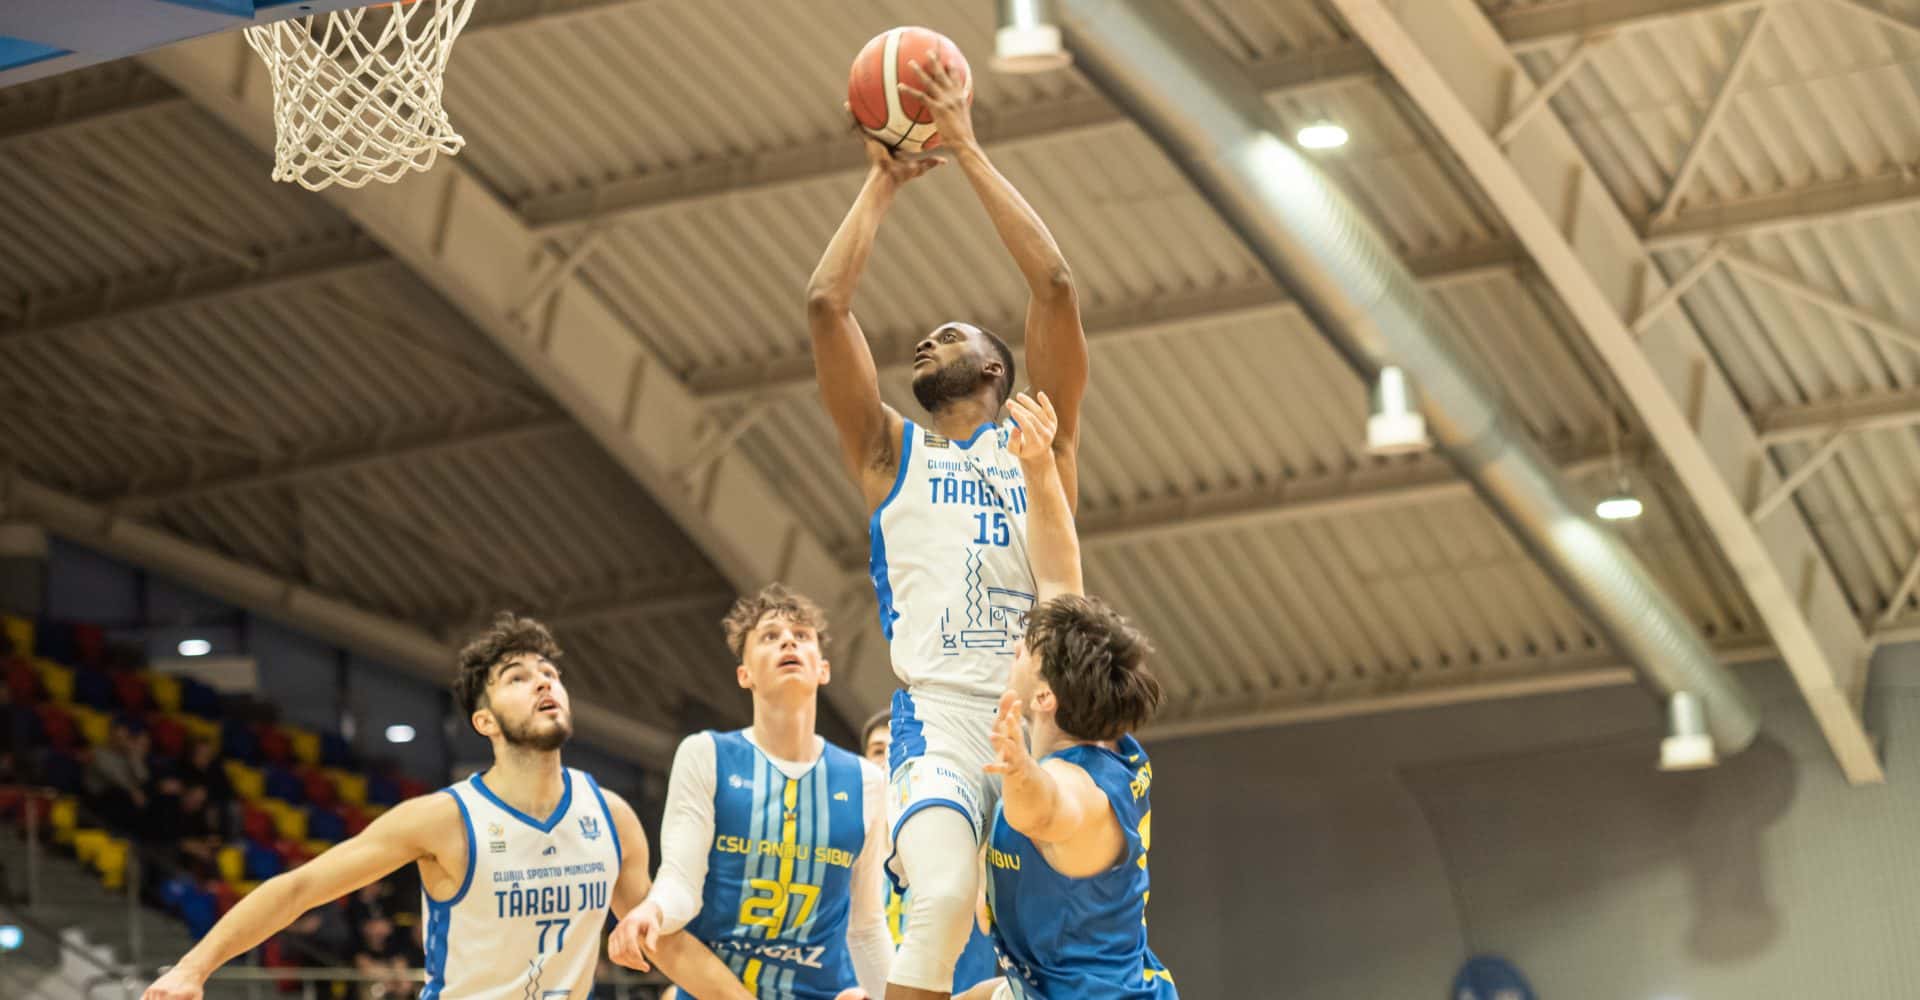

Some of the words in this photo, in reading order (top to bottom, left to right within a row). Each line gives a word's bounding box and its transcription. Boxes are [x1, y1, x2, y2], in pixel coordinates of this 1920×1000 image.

[973, 511, 1010, 547] 15
[716, 834, 753, 855] CSU
[814, 847, 855, 869] SIBIU
[987, 848, 1021, 871] IBIU
[493, 870, 525, 882] CLUBUL
[526, 866, 562, 879] SPORTIV
[564, 861, 606, 876] MUNICIPAL
[494, 882, 571, 918] TÂRGU
[577, 880, 607, 911] JIU
[739, 879, 822, 929] 27
[535, 918, 571, 954] 77
